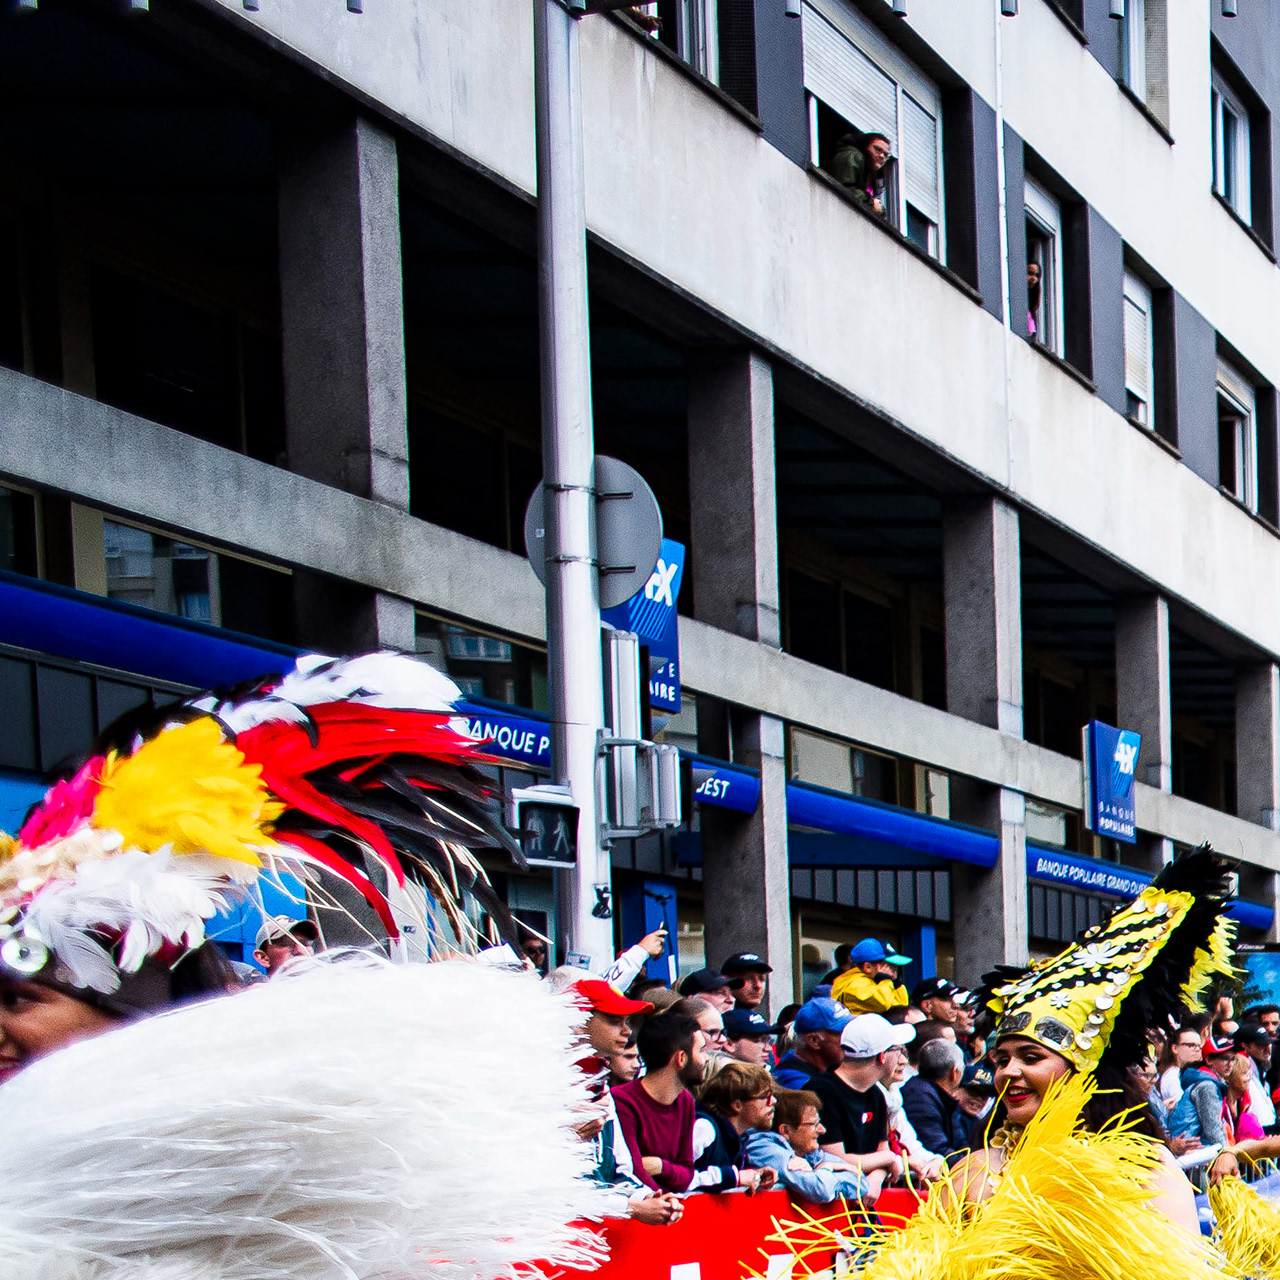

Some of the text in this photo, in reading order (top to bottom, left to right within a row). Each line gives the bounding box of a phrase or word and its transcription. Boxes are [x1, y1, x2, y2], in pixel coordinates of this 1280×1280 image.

[466, 718, 536, 754] ANQUE
[1098, 800, 1135, 820] BANQUE
[1098, 816, 1135, 837] POPULAIRE
[1036, 857, 1069, 878] BANQUE
[1068, 865, 1107, 887] POPULAIRE
[1106, 875, 1131, 893] GRAND
